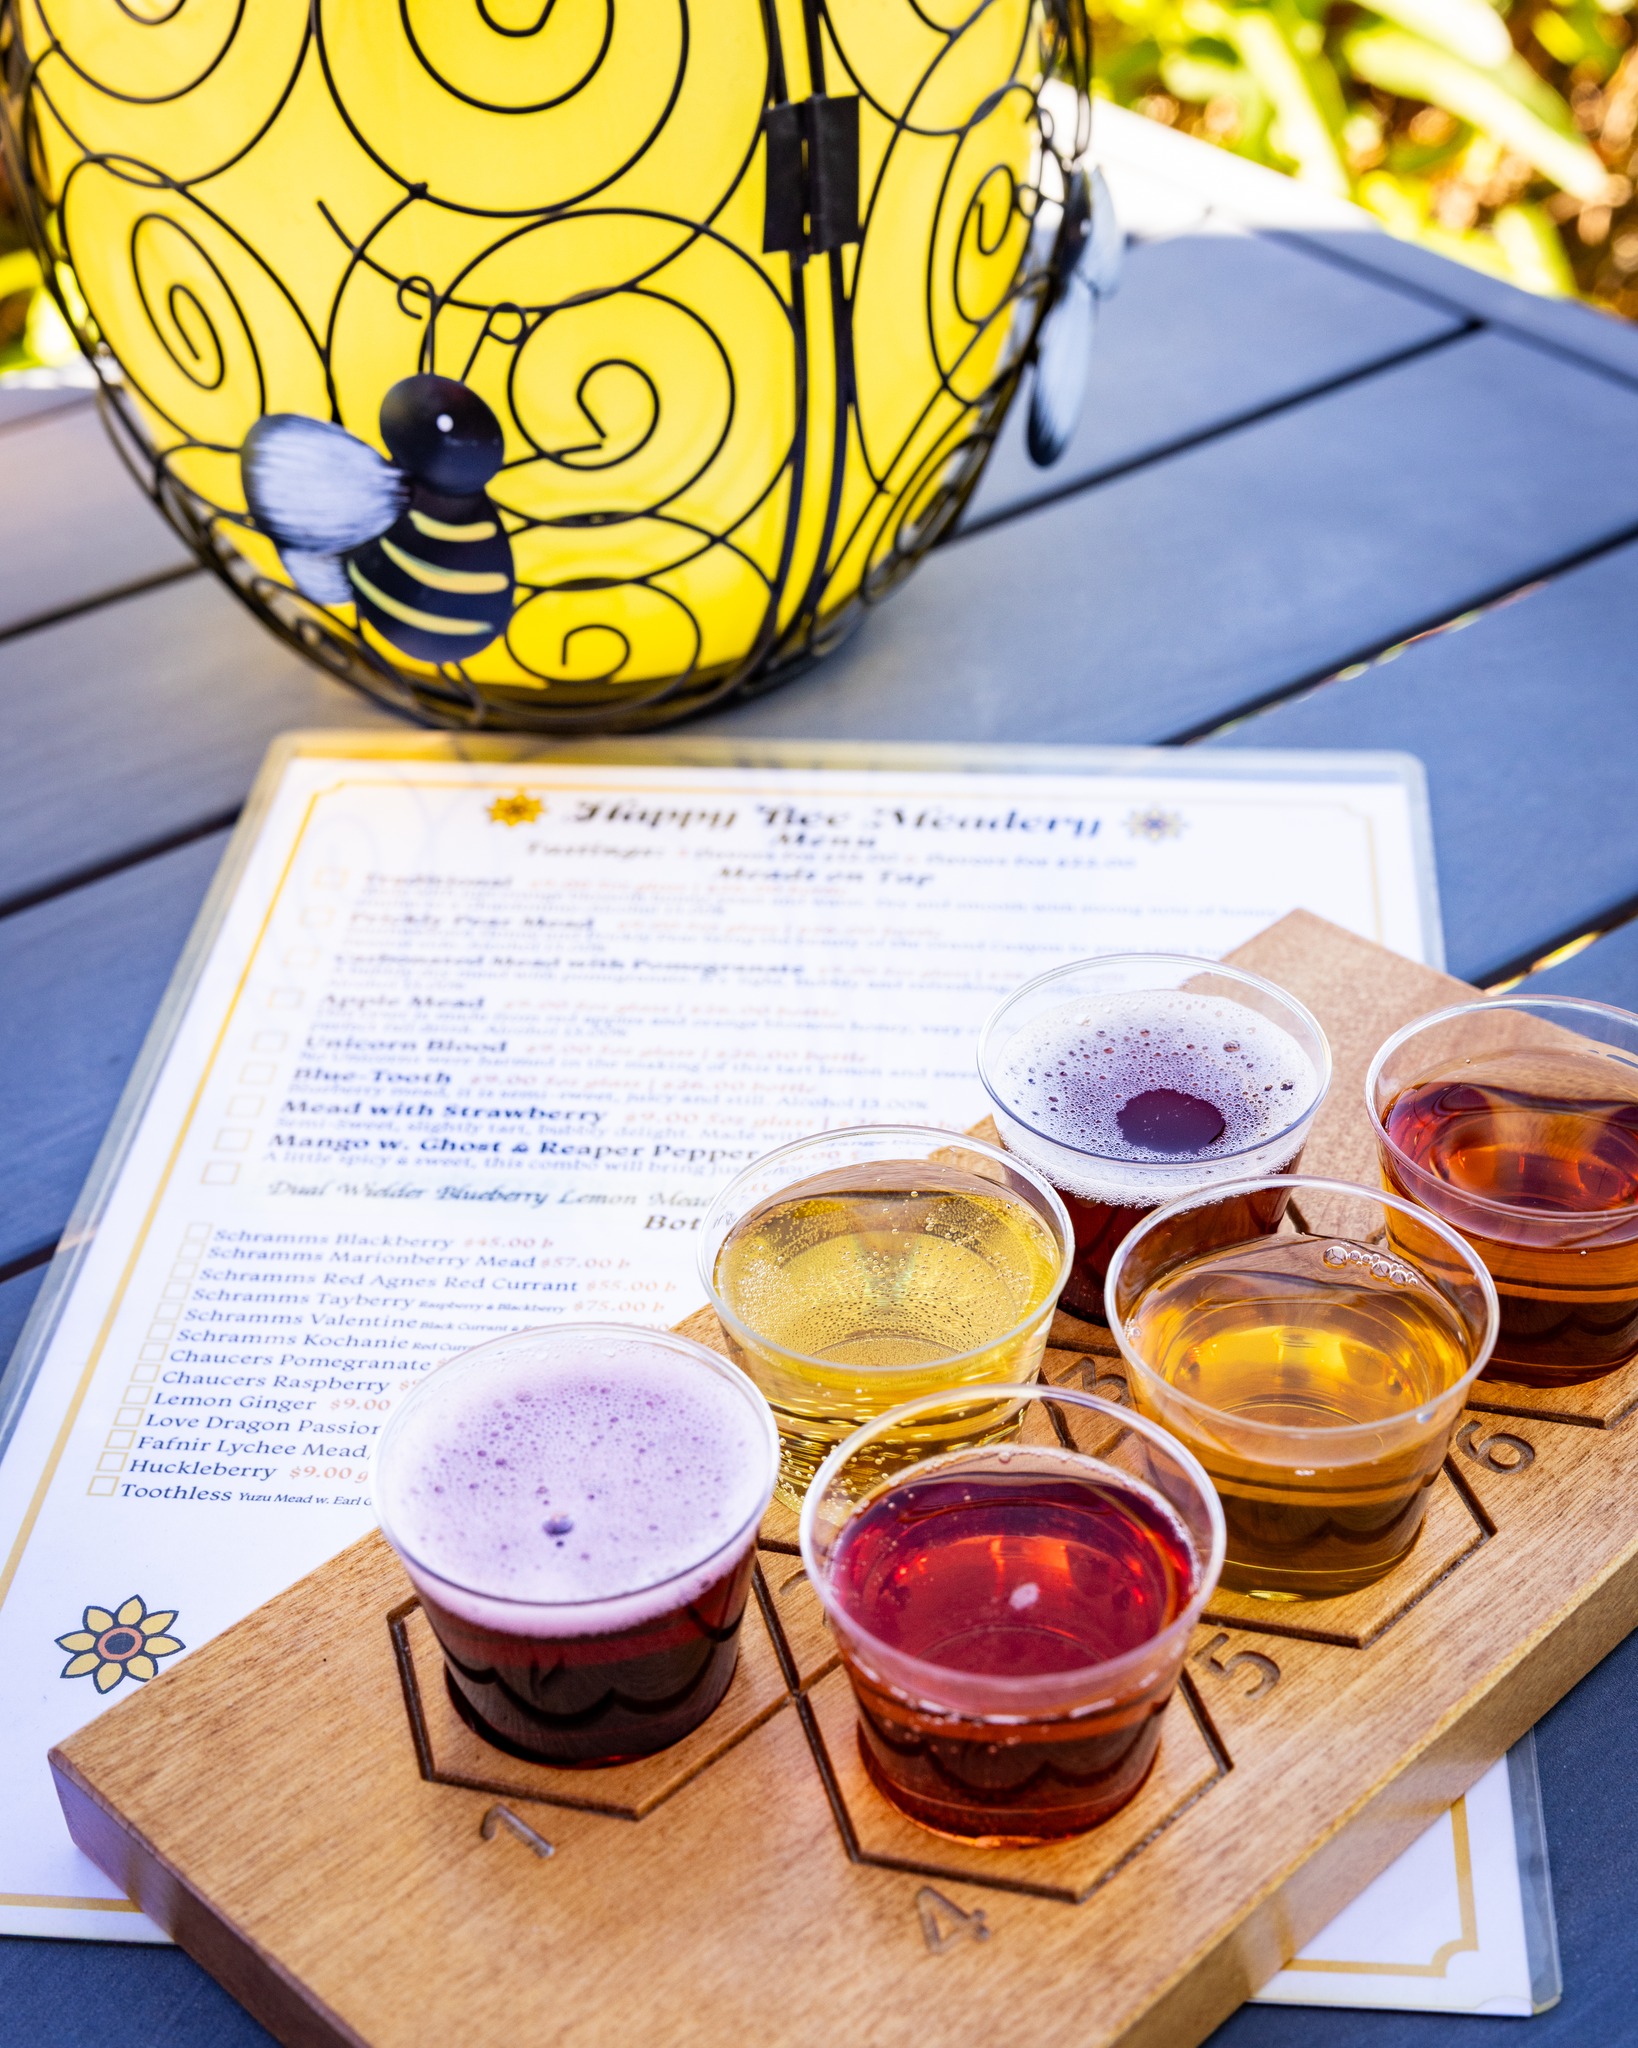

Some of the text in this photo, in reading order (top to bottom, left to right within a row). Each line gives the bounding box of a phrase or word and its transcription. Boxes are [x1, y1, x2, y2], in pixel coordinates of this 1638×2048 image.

[566, 798, 1102, 838] Happy Bee Meadery
[306, 1034, 417, 1048] Unicorn
[427, 1037, 508, 1052] Blood
[281, 1101, 361, 1115] Mead
[370, 1103, 433, 1116] with
[444, 1105, 607, 1126] Strawberry
[271, 1134, 369, 1151] Mango
[420, 1136, 500, 1150] Ghost
[539, 1140, 644, 1159] Reaper
[652, 1143, 758, 1161] Pepper
[267, 1180, 334, 1196] Dual
[436, 1185, 549, 1207] Blueberry
[557, 1190, 637, 1205] Lemon
[215, 1229, 328, 1243] Schramms
[335, 1232, 455, 1250] Blackberry
[209, 1247, 322, 1261] Schramms
[328, 1250, 469, 1269] Marionberry
[475, 1254, 536, 1266] Mead
[540, 1257, 611, 1268] $57.00
[201, 1268, 316, 1283] Schramms
[323, 1271, 365, 1284] Red
[369, 1273, 437, 1289] Agnes
[444, 1275, 486, 1287] Red
[490, 1276, 577, 1290] Currant
[585, 1279, 659, 1291] $55.00
[192, 1287, 310, 1302] Schramms
[317, 1291, 415, 1309] Tayberry
[497, 1303, 566, 1312] Blackberry
[574, 1300, 645, 1312] $75.00
[184, 1308, 304, 1324] Schramms
[311, 1313, 417, 1327] Valentine
[457, 1322, 508, 1330] Currant
[175, 1328, 297, 1344] Schramms
[303, 1333, 409, 1348] Kochanie
[411, 1341, 437, 1349] Red
[168, 1349, 273, 1365] Chaucers
[279, 1353, 432, 1373] Pomegranate
[160, 1371, 266, 1386] Chaucers
[271, 1374, 390, 1394] Raspberry
[153, 1392, 391, 1412] Lemon Ginger $9.00
[145, 1414, 199, 1428] Love
[205, 1416, 290, 1435] Dragon
[137, 1436, 371, 1459] Fafnir Lychee Mead,
[1455, 1420, 1536, 1475] 6
[128, 1459, 278, 1480] Huckleberry
[288, 1465, 352, 1479] $9.00
[120, 1483, 232, 1500] Toothless
[238, 1491, 274, 1501] Yuzu
[276, 1493, 312, 1503] Mead
[334, 1495, 362, 1505] Earl
[1193, 1632, 1281, 1700] 5
[480, 1803, 555, 1858] 1
[916, 1885, 991, 1954] 4
